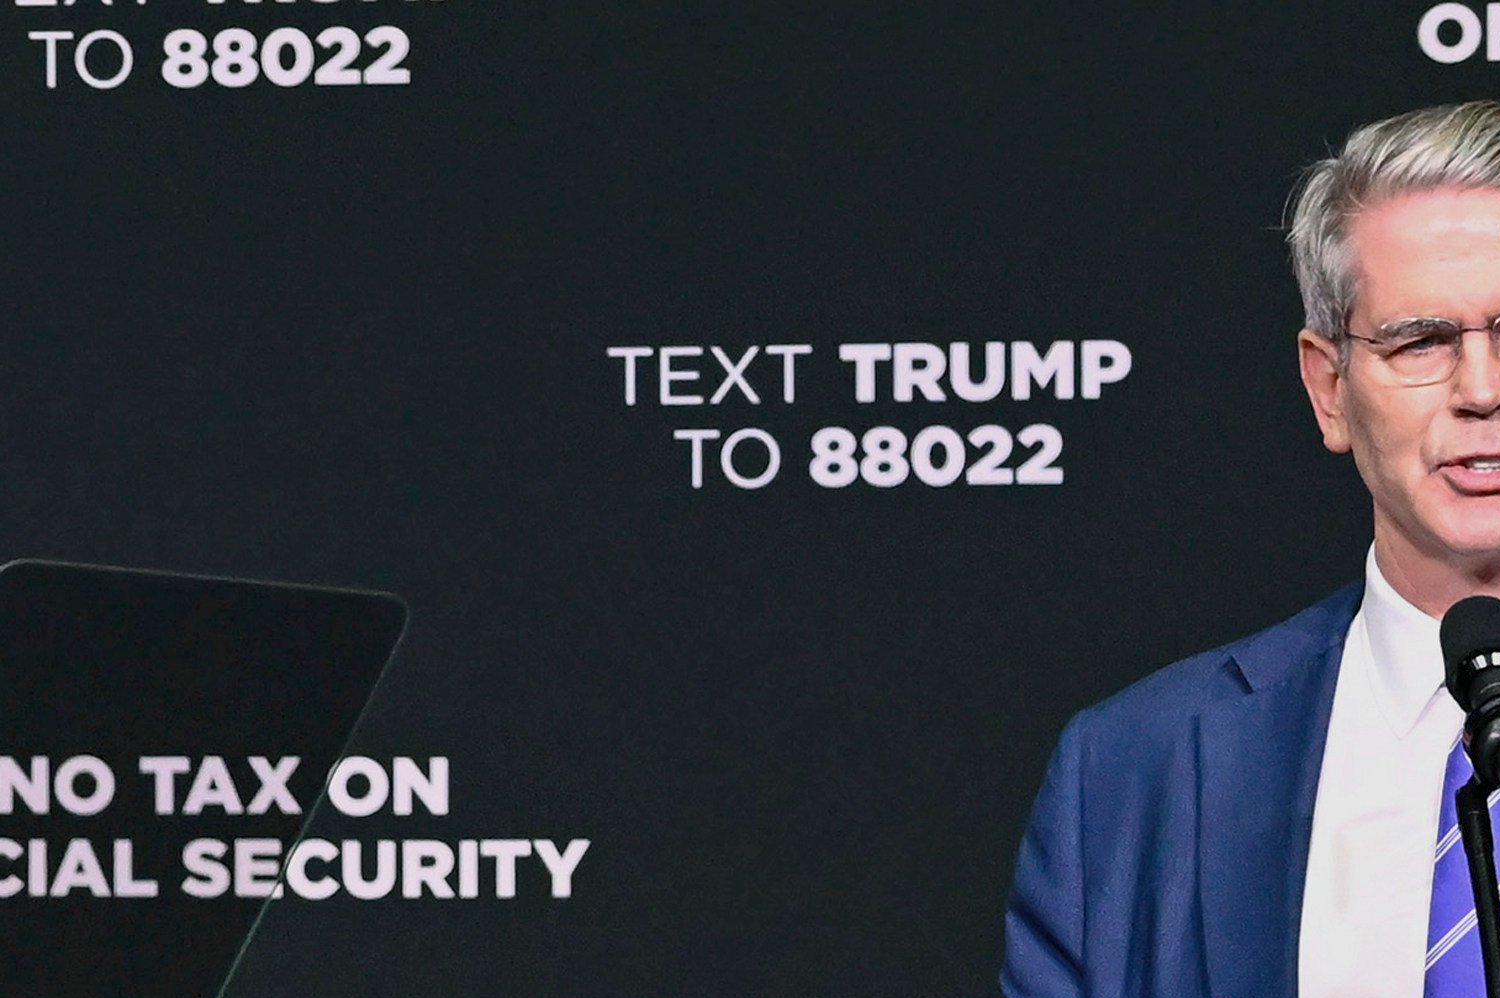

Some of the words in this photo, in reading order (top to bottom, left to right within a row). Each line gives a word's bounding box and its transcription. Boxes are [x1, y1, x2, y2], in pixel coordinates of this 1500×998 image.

[28, 29, 134, 90] TO
[161, 25, 411, 89] 88022
[606, 344, 813, 406] TEXT
[838, 339, 1132, 403] TRUMP
[673, 427, 781, 490] TO
[809, 423, 1064, 488] 88022
[0, 755, 115, 816] NO
[139, 755, 302, 815] TAX
[326, 755, 449, 817] ON
[181, 838, 591, 900] SECURITY
